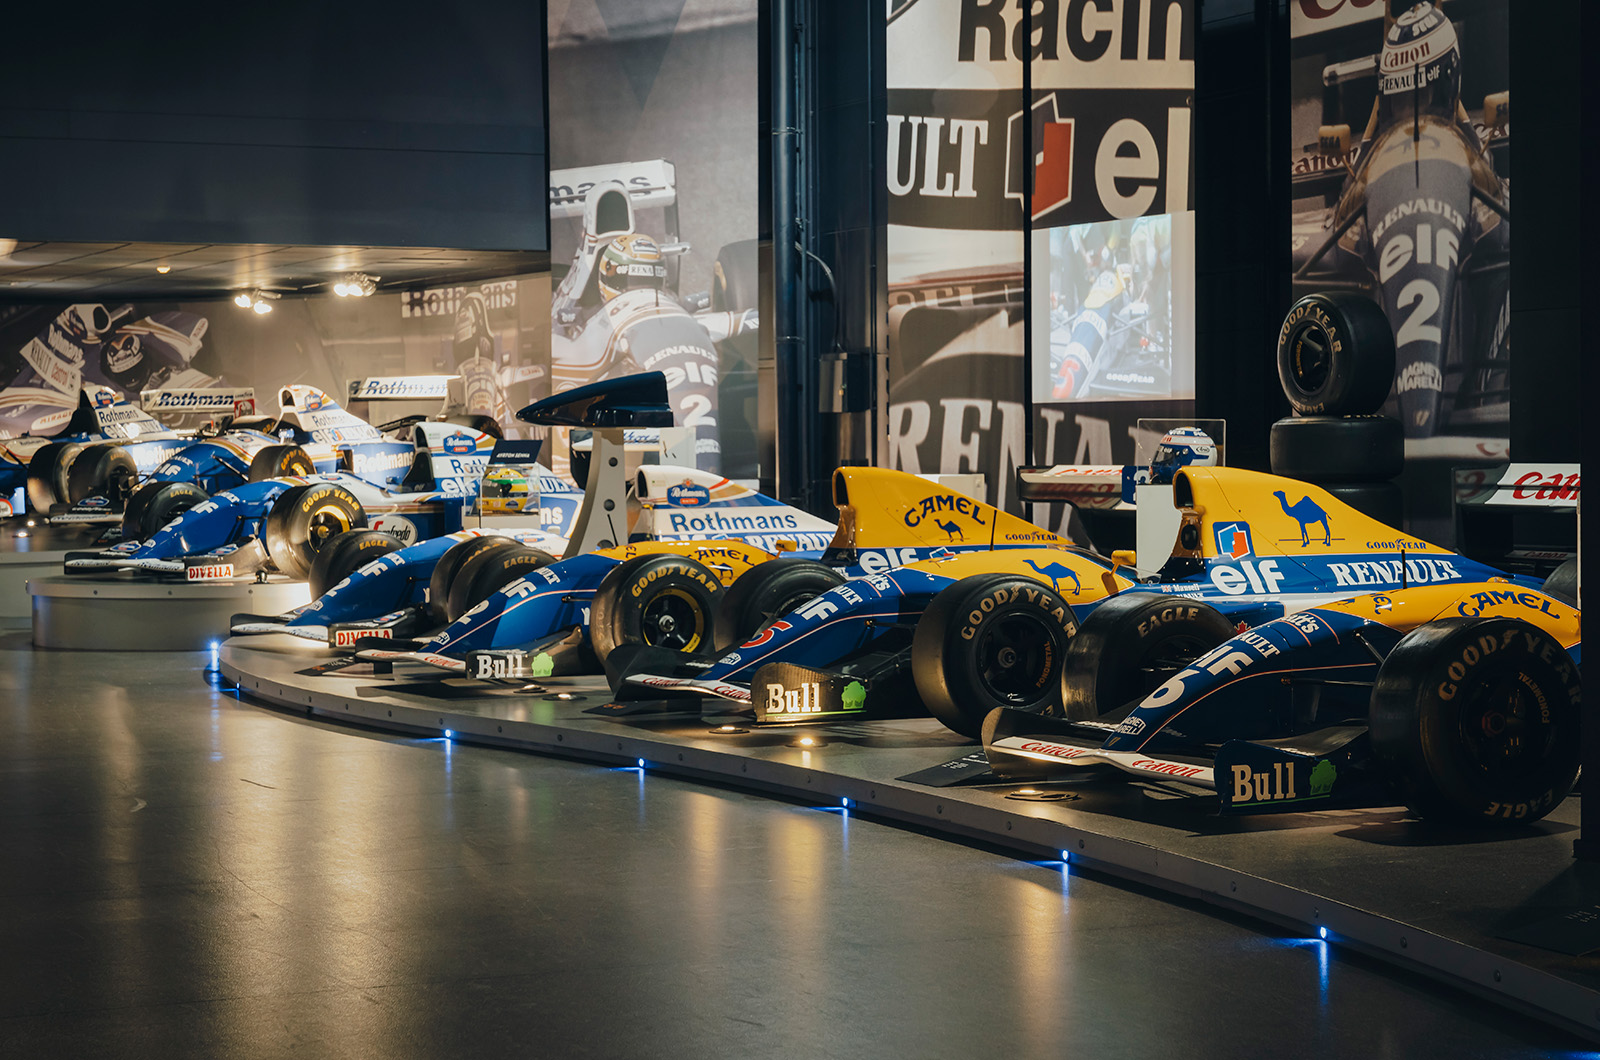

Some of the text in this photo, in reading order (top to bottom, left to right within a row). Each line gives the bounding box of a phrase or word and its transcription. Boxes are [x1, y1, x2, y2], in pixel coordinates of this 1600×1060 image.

[1384, 42, 1430, 68] Canon
[1385, 70, 1425, 91] RENAUT
[1372, 199, 1466, 248] RENAULT
[1379, 223, 1459, 285] elf
[1397, 279, 1441, 348] 2
[644, 345, 718, 370] RENAULT
[664, 362, 718, 390] elf
[680, 394, 717, 428] 2
[670, 512, 797, 532] Rothmans
[904, 495, 986, 527] CAMEL
[359, 540, 388, 550] EAGLE
[689, 550, 755, 567] AMEL
[189, 565, 232, 579] DIVELLA
[504, 556, 537, 569] EAGLE
[860, 548, 919, 575] elf
[1327, 559, 1462, 586] RENAULT
[1210, 559, 1285, 595] elf
[1458, 590, 1560, 619] CAMEL
[1137, 607, 1199, 638] EAGLE
[476, 652, 523, 678] Bull
[1036, 641, 1053, 688] FONDMETAL
[766, 682, 821, 714] Bull
[1021, 742, 1086, 758] Canon
[1132, 759, 1206, 777] Canon
[1231, 762, 1296, 802] Bull
